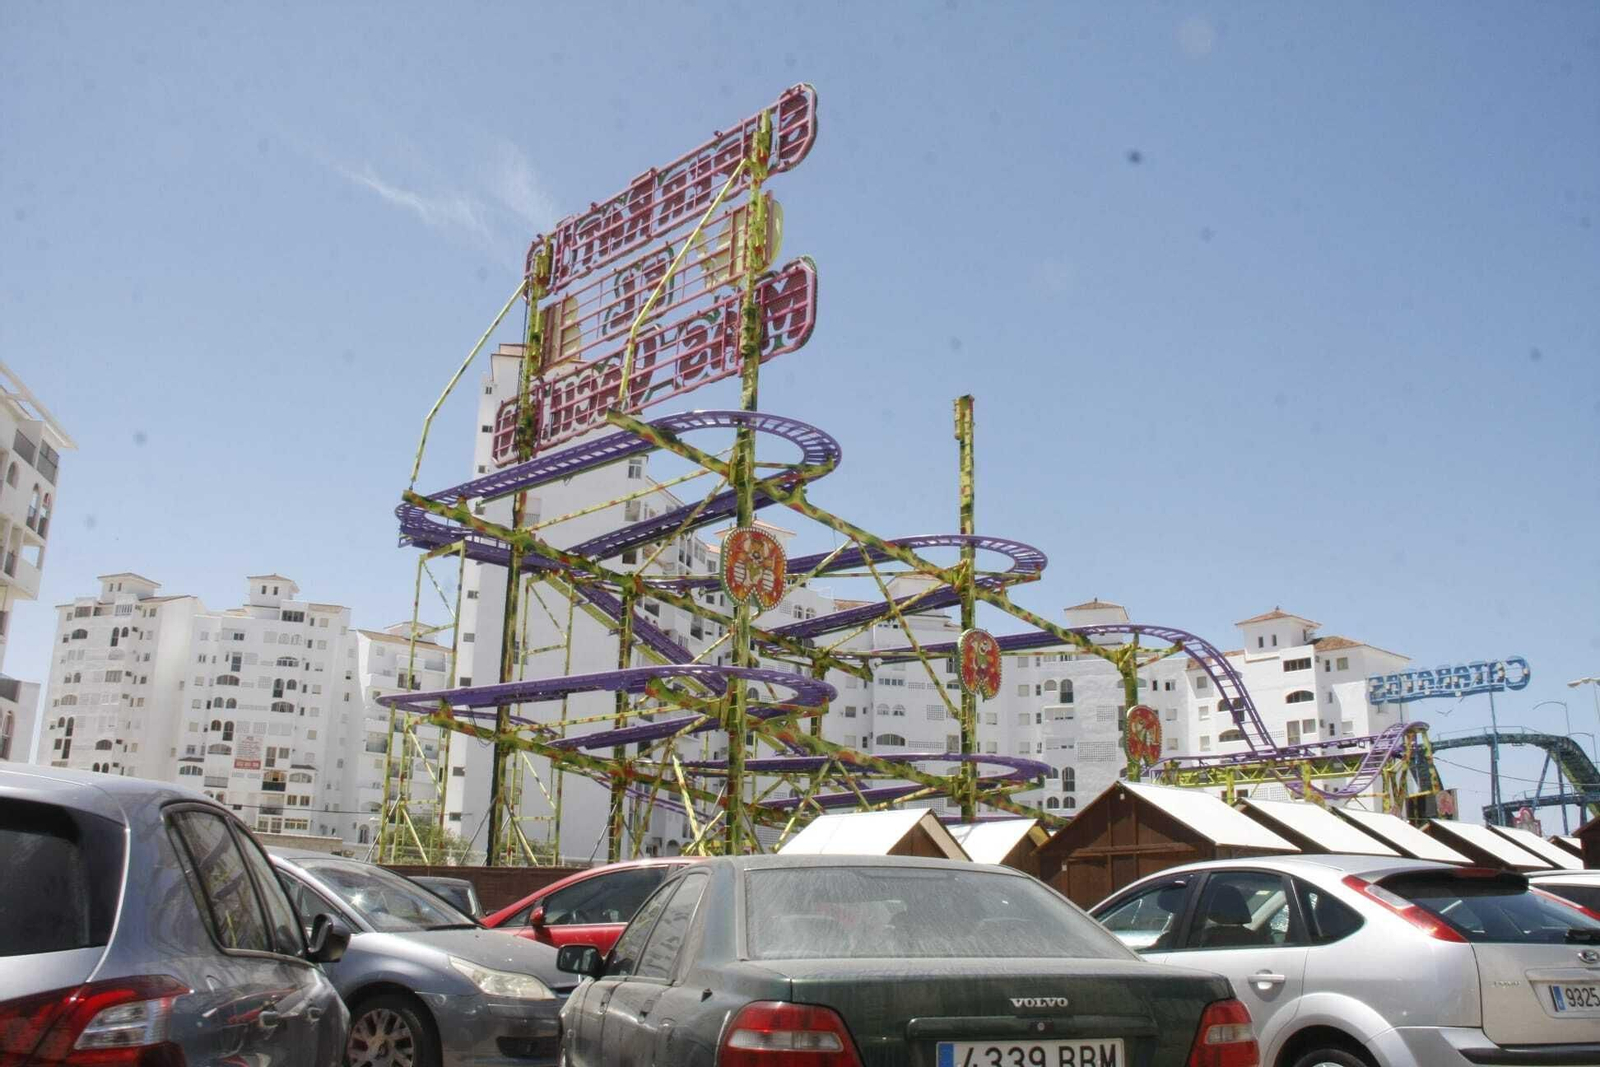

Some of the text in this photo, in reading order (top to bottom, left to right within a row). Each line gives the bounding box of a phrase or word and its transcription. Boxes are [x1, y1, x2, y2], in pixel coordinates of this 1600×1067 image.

[1008, 997, 1068, 1008] VOLVO
[1565, 987, 1600, 1007] 9325
[962, 1046, 1046, 1067] 4339
